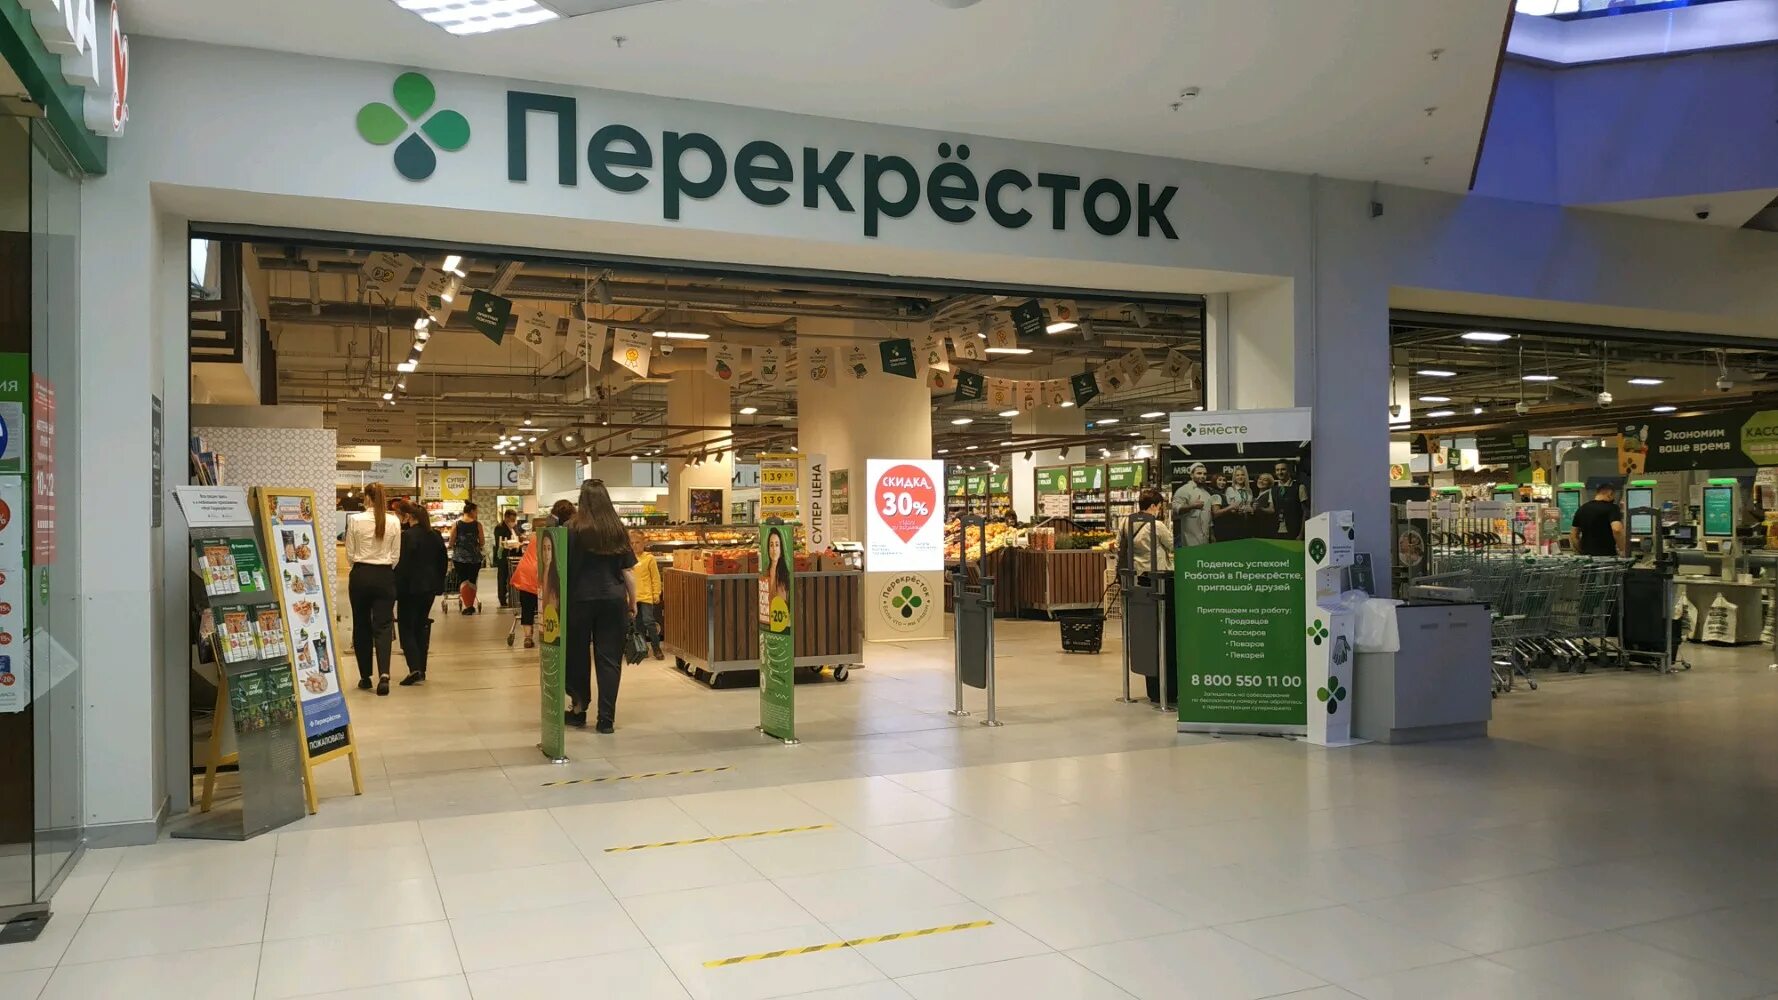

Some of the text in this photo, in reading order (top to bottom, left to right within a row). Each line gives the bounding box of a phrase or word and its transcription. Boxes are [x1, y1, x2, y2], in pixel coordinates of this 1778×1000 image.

[507, 91, 1179, 237] Перекрёсток
[1664, 429, 1725, 441] Экономим
[1659, 442, 1731, 454] ваше время
[763, 473, 782, 481] 139
[882, 476, 932, 489] СКИДКА
[812, 464, 823, 544] СУПЕР ЦЕНА
[882, 492, 929, 517] 30%
[1197, 559, 1290, 569] Поделись успехом!
[1184, 571, 1226, 580] Работай
[1235, 571, 1303, 581] Перекрёстке,
[883, 575, 930, 599] Перекрёсток
[1197, 583, 1291, 592] приглашай друзей
[1197, 606, 1248, 615] Приглашаем
[1261, 606, 1292, 615] работу:
[1225, 617, 1269, 625] Продавцов
[1228, 629, 1267, 637] Кассиров
[1230, 640, 1265, 648] Поваров
[1230, 651, 1265, 659] Пекарей
[1191, 674, 1302, 688] 8 800 550 11 00
